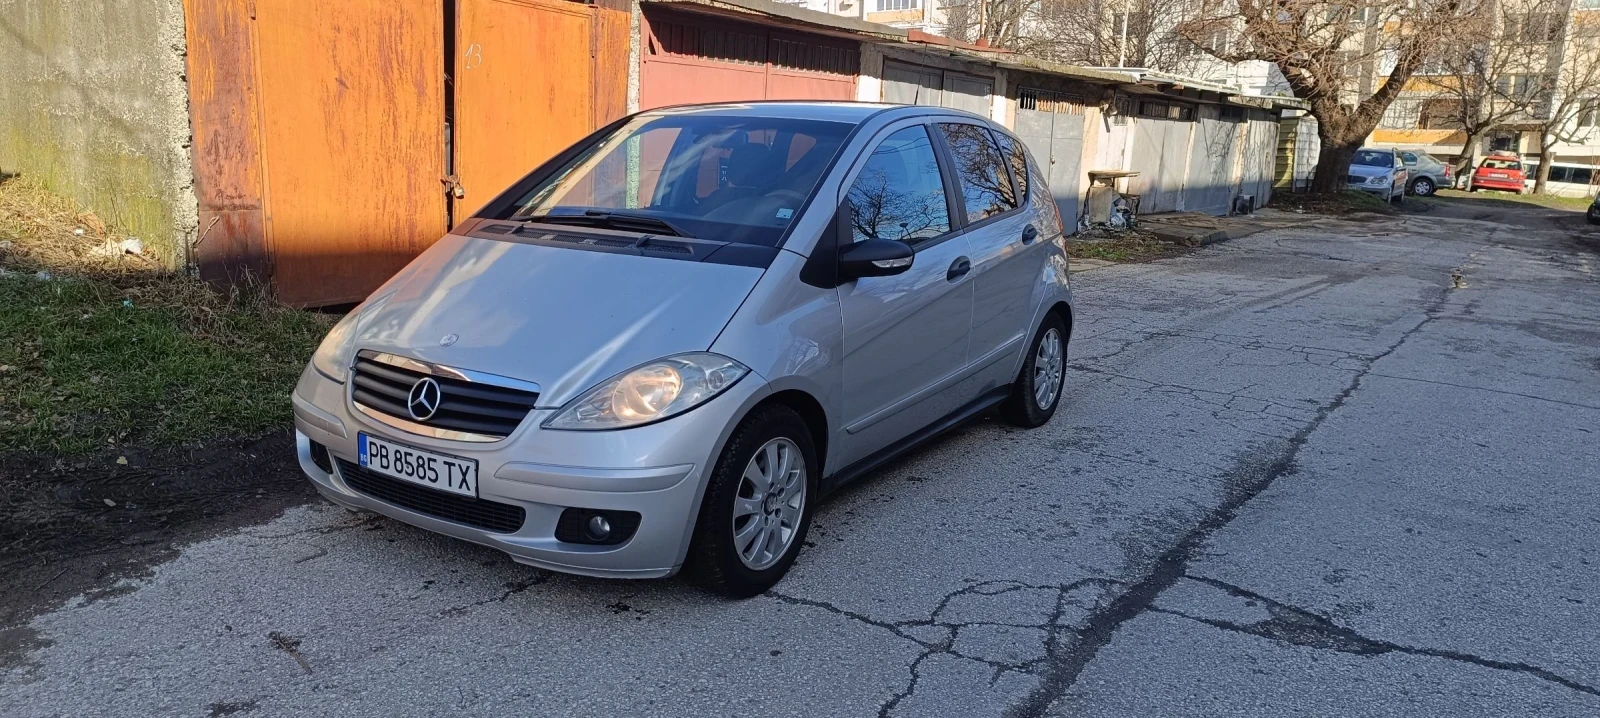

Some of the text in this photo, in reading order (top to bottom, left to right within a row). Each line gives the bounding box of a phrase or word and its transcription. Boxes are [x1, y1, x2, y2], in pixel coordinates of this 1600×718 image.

[465, 43, 482, 69] 13
[369, 441, 471, 492] PB 8585 TX
